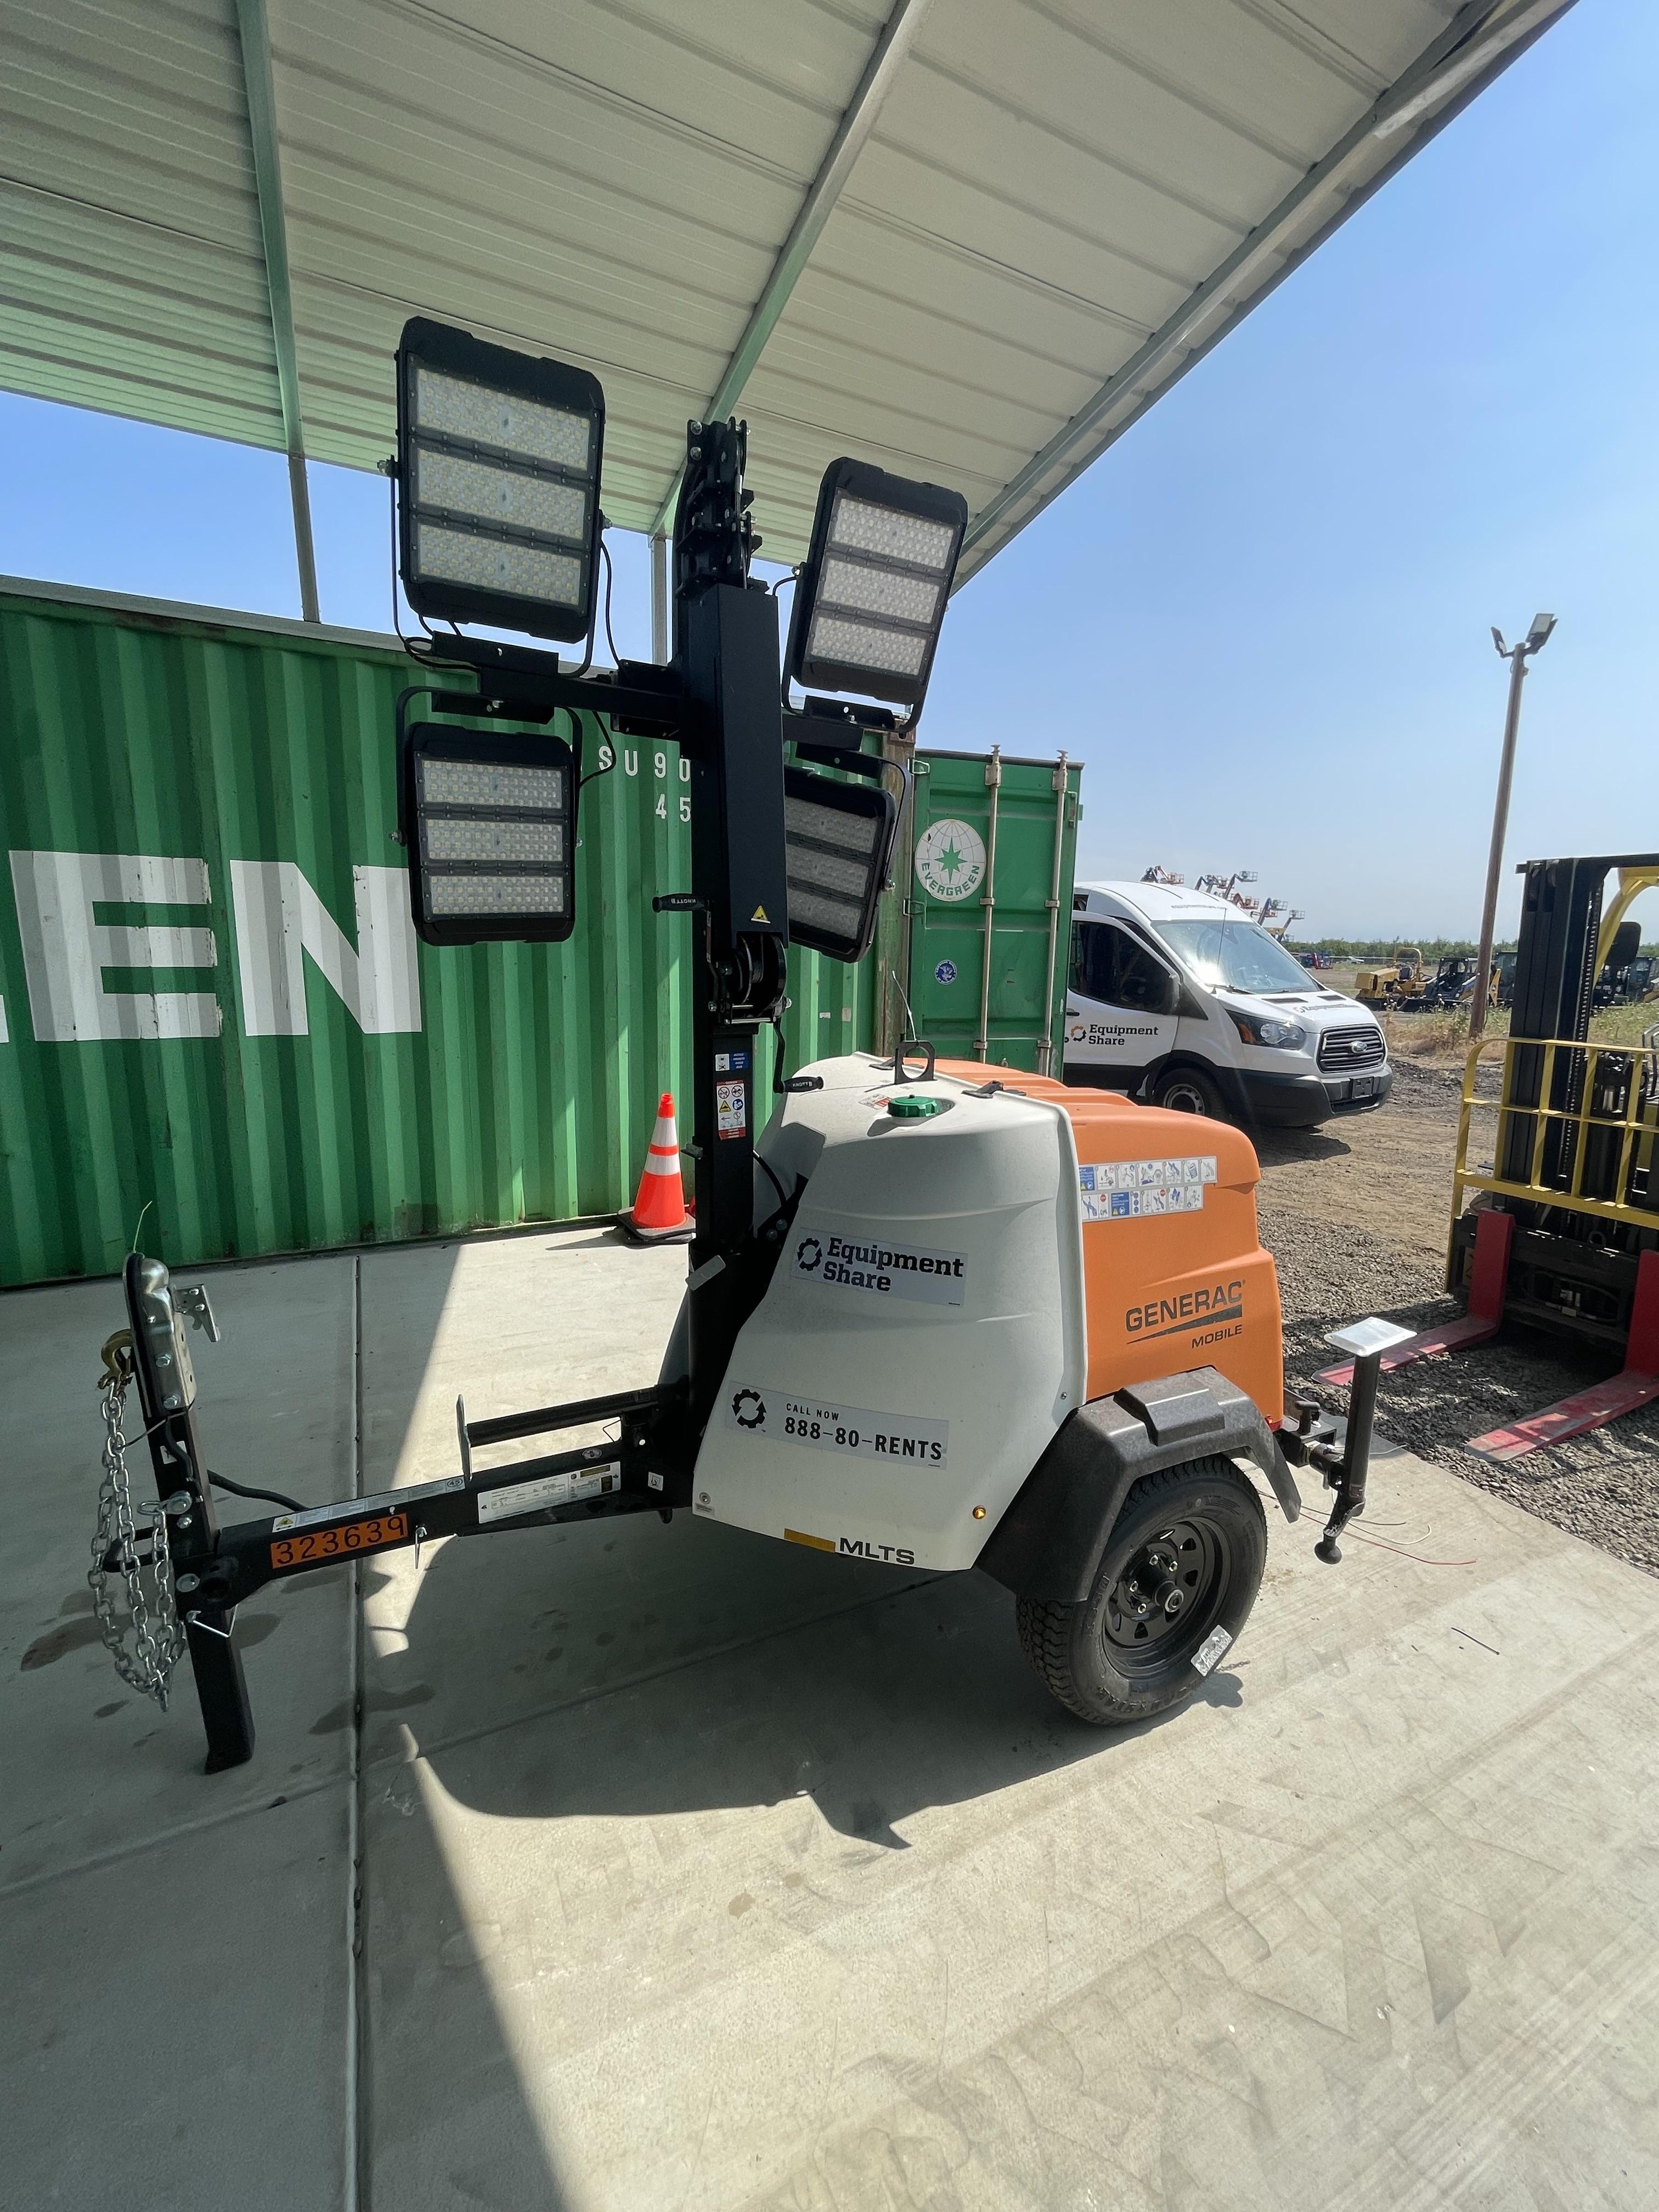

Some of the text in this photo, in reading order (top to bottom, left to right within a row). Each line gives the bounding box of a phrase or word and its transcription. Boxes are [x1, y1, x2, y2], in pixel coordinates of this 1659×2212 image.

[921, 862, 980, 896] EVERGREEN
[0, 851, 422, 1042] EN
[1088, 1035, 1125, 1045] Share
[1089, 1024, 1159, 1036] Equipment
[827, 1237, 964, 1278] Equipment
[823, 1261, 891, 1291] Share
[1126, 1280, 1243, 1332] GENERAC
[1192, 1324, 1243, 1348] MOBILE
[786, 1403, 839, 1421] CALL NOW
[785, 1417, 942, 1460] 888-80-RENTS
[275, 1515, 404, 1564] 323639
[840, 1537, 915, 1565] MLTS
